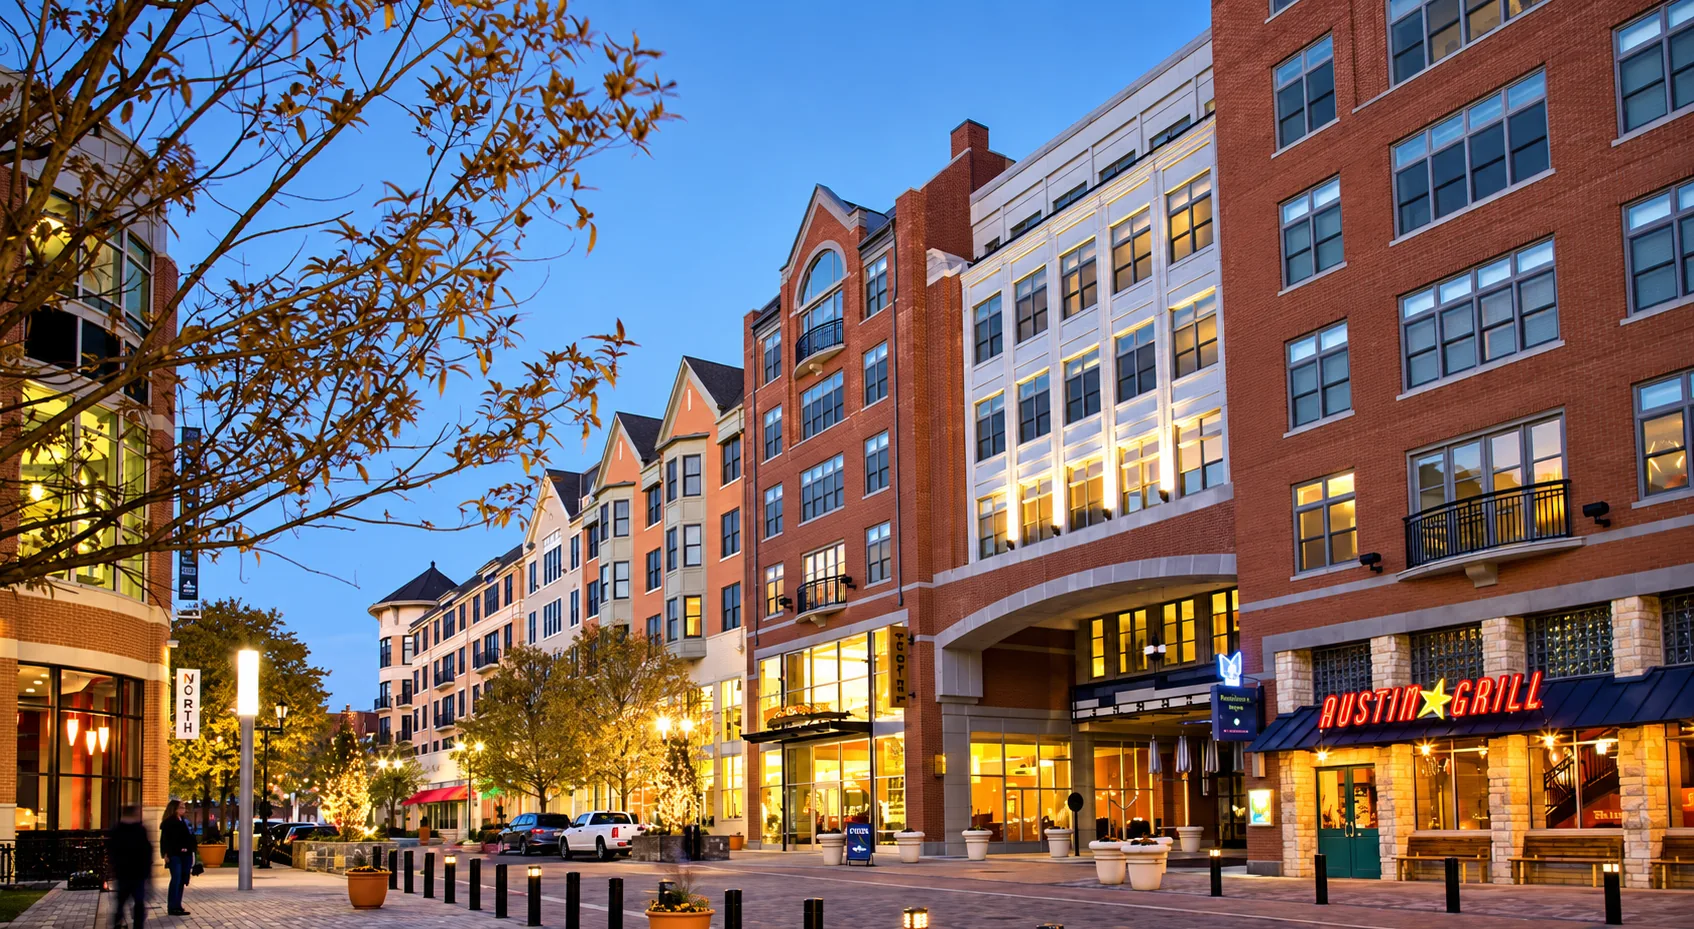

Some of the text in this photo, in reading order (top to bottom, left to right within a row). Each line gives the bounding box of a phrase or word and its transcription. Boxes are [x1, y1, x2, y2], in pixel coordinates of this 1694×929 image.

[183, 673, 194, 733] NORTH
[1318, 670, 1543, 729] AUSTIN GRILL
